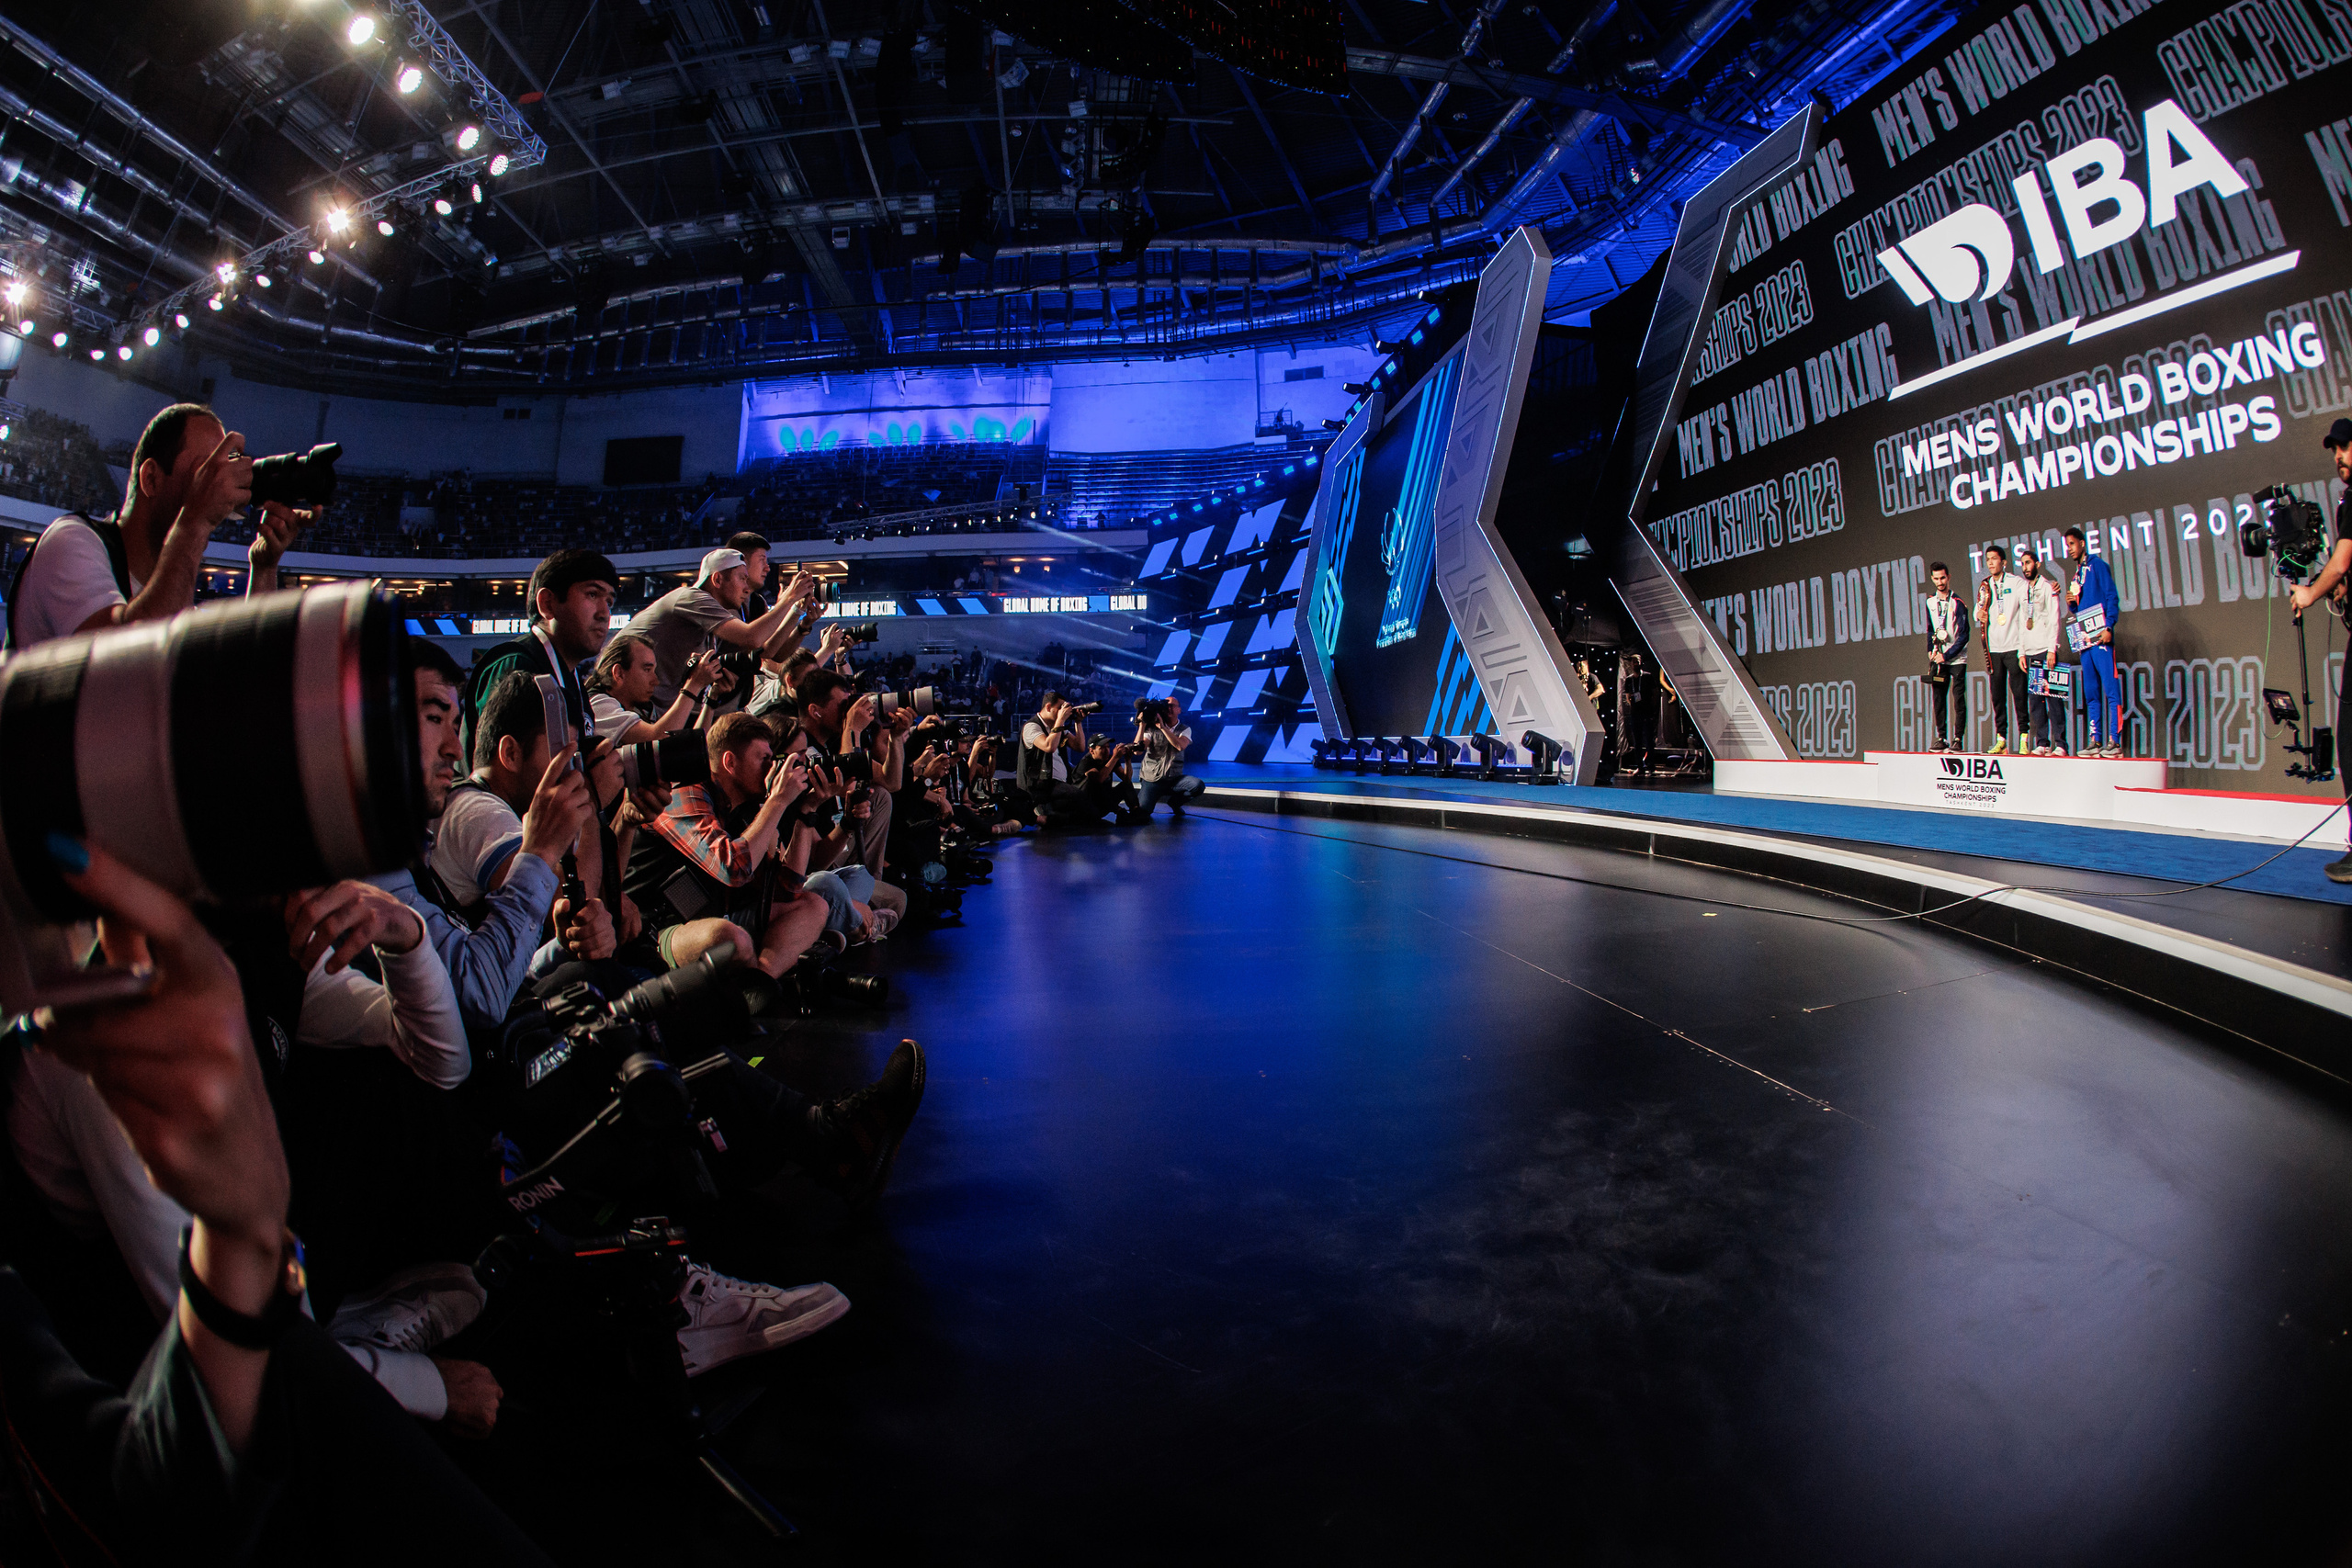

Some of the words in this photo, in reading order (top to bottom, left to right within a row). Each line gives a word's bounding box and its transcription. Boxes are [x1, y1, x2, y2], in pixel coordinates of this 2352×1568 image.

[1871, 67, 1959, 168] MEN'S
[1944, 4, 2056, 116] WORLD
[1769, 138, 1856, 243] BOXING
[2012, 98, 2250, 276] IBA
[1753, 259, 1815, 347] 2023
[1677, 401, 1732, 479] MEN'S
[1731, 367, 1806, 455] WORLD
[1804, 321, 1901, 424] BOXING
[1902, 419, 2001, 478] MENS
[2005, 372, 2153, 446] WORLD
[2155, 321, 2325, 406] BOXING
[1950, 396, 2282, 510] CHAMPIONSHIPS
[1782, 457, 1846, 543] 2023
[1969, 520, 2154, 574] TSHENT
[1750, 576, 1826, 654] WORLD
[1831, 555, 1928, 644] BOXING
[1796, 680, 1857, 759] 2023
[2165, 656, 2266, 772] 2023
[1943, 792, 1997, 803] CHAMPIONSHIPS
[1955, 784, 1979, 793] WORLD
[1980, 786, 2007, 795] BOXING
[1967, 759, 2004, 780] IBA
[508, 1176, 565, 1212] RONIN
